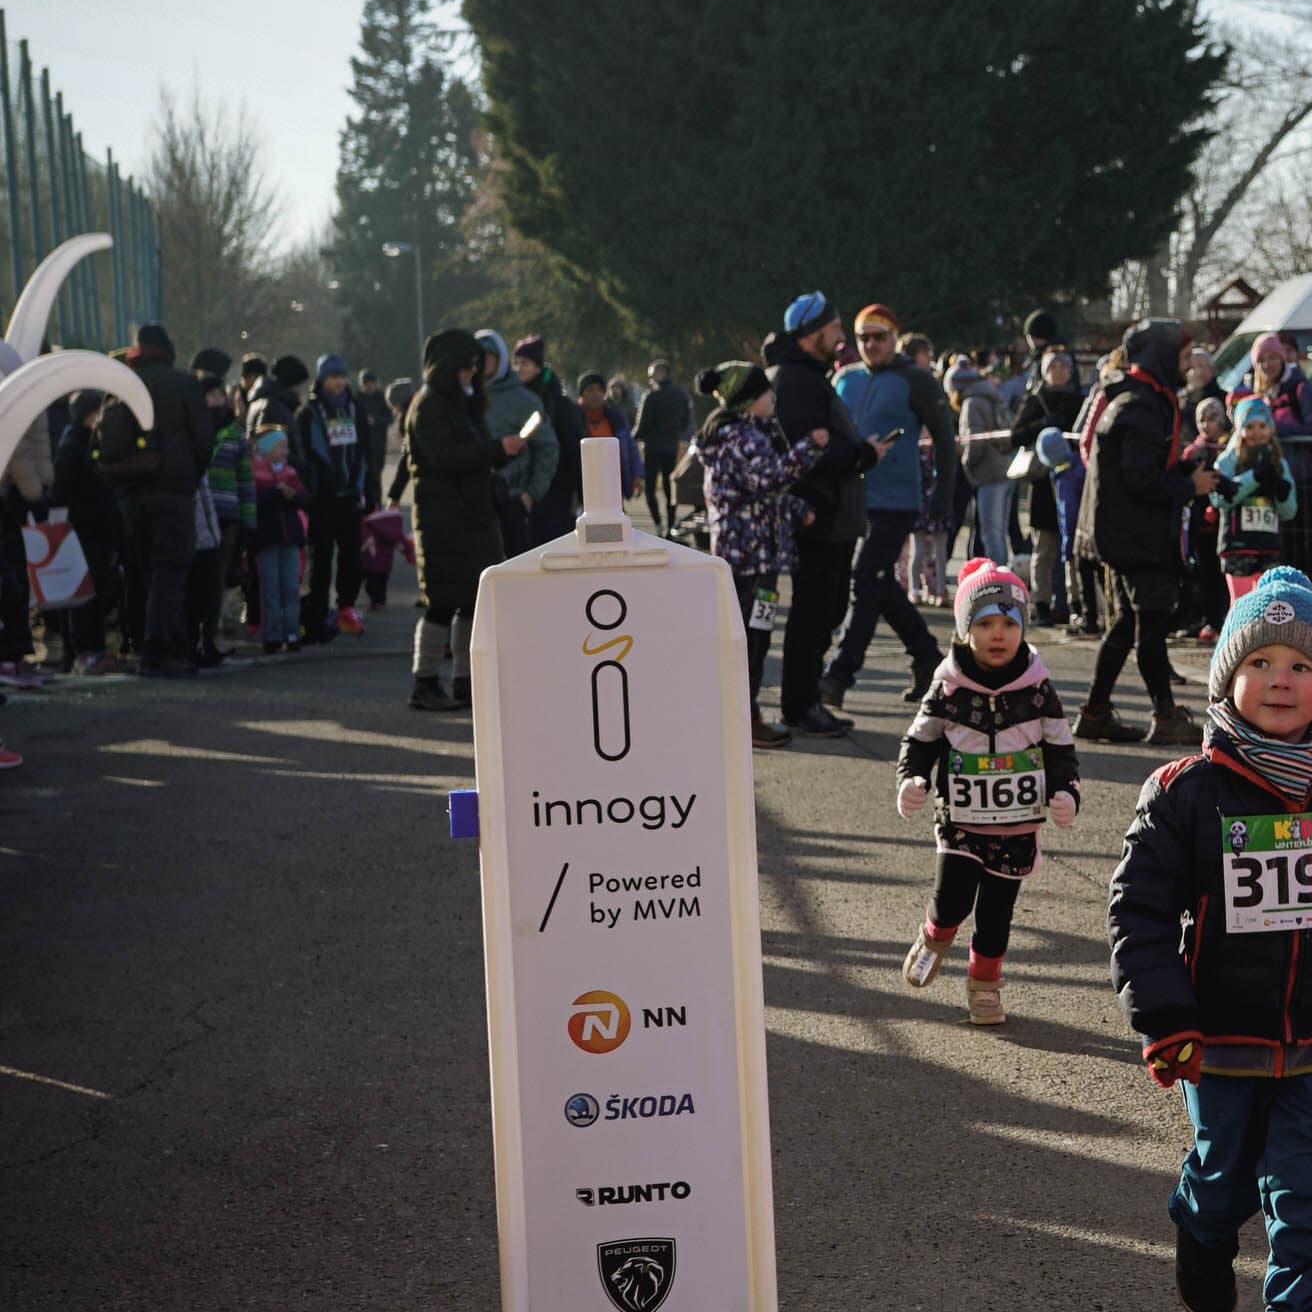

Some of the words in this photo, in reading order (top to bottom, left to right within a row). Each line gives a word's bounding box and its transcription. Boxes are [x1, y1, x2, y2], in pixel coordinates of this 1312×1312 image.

[953, 775, 1038, 808] 3168
[532, 791, 697, 830] innogy
[589, 867, 701, 894] Powered
[590, 903, 622, 929] by
[633, 896, 701, 922] MVM
[642, 1005, 688, 1029] NN
[604, 1093, 696, 1120] ŠKODA
[598, 1180, 692, 1206] RUNTO
[604, 1244, 669, 1257] PEUGEOT
